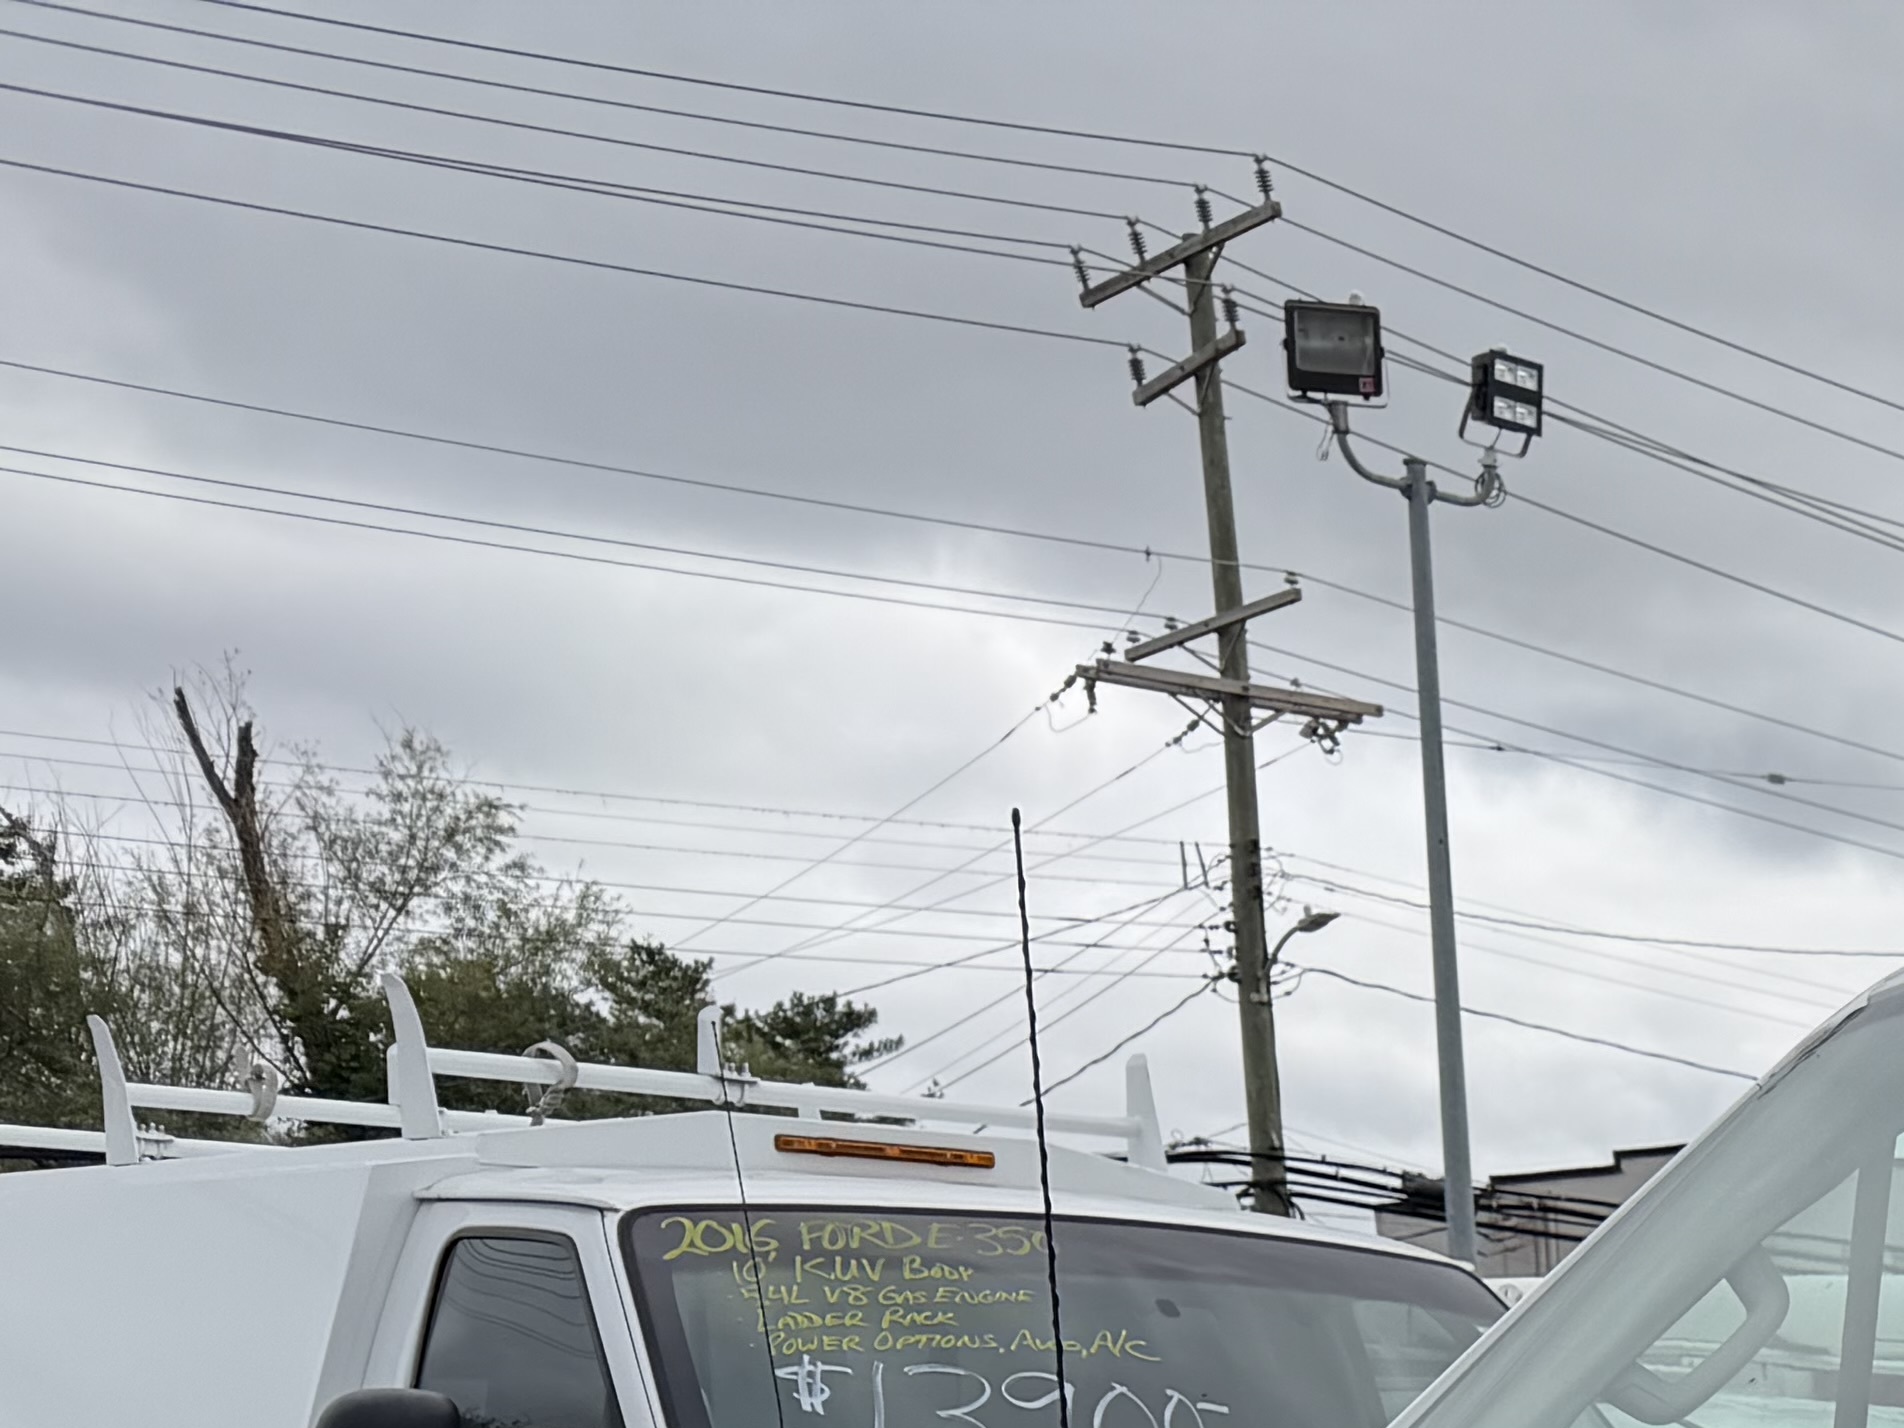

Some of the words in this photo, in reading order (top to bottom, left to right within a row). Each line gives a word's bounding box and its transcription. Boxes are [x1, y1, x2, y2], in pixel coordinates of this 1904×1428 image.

[660, 1215, 780, 1261] 2016
[800, 1218, 922, 1251] FORD
[823, 1284, 874, 1306] V8
[878, 1284, 928, 1306] GAS
[933, 1286, 1037, 1306] ENGINE
[757, 1308, 871, 1333] LADDER
[881, 1306, 961, 1331] RACK
[768, 1331, 866, 1356] POWER
